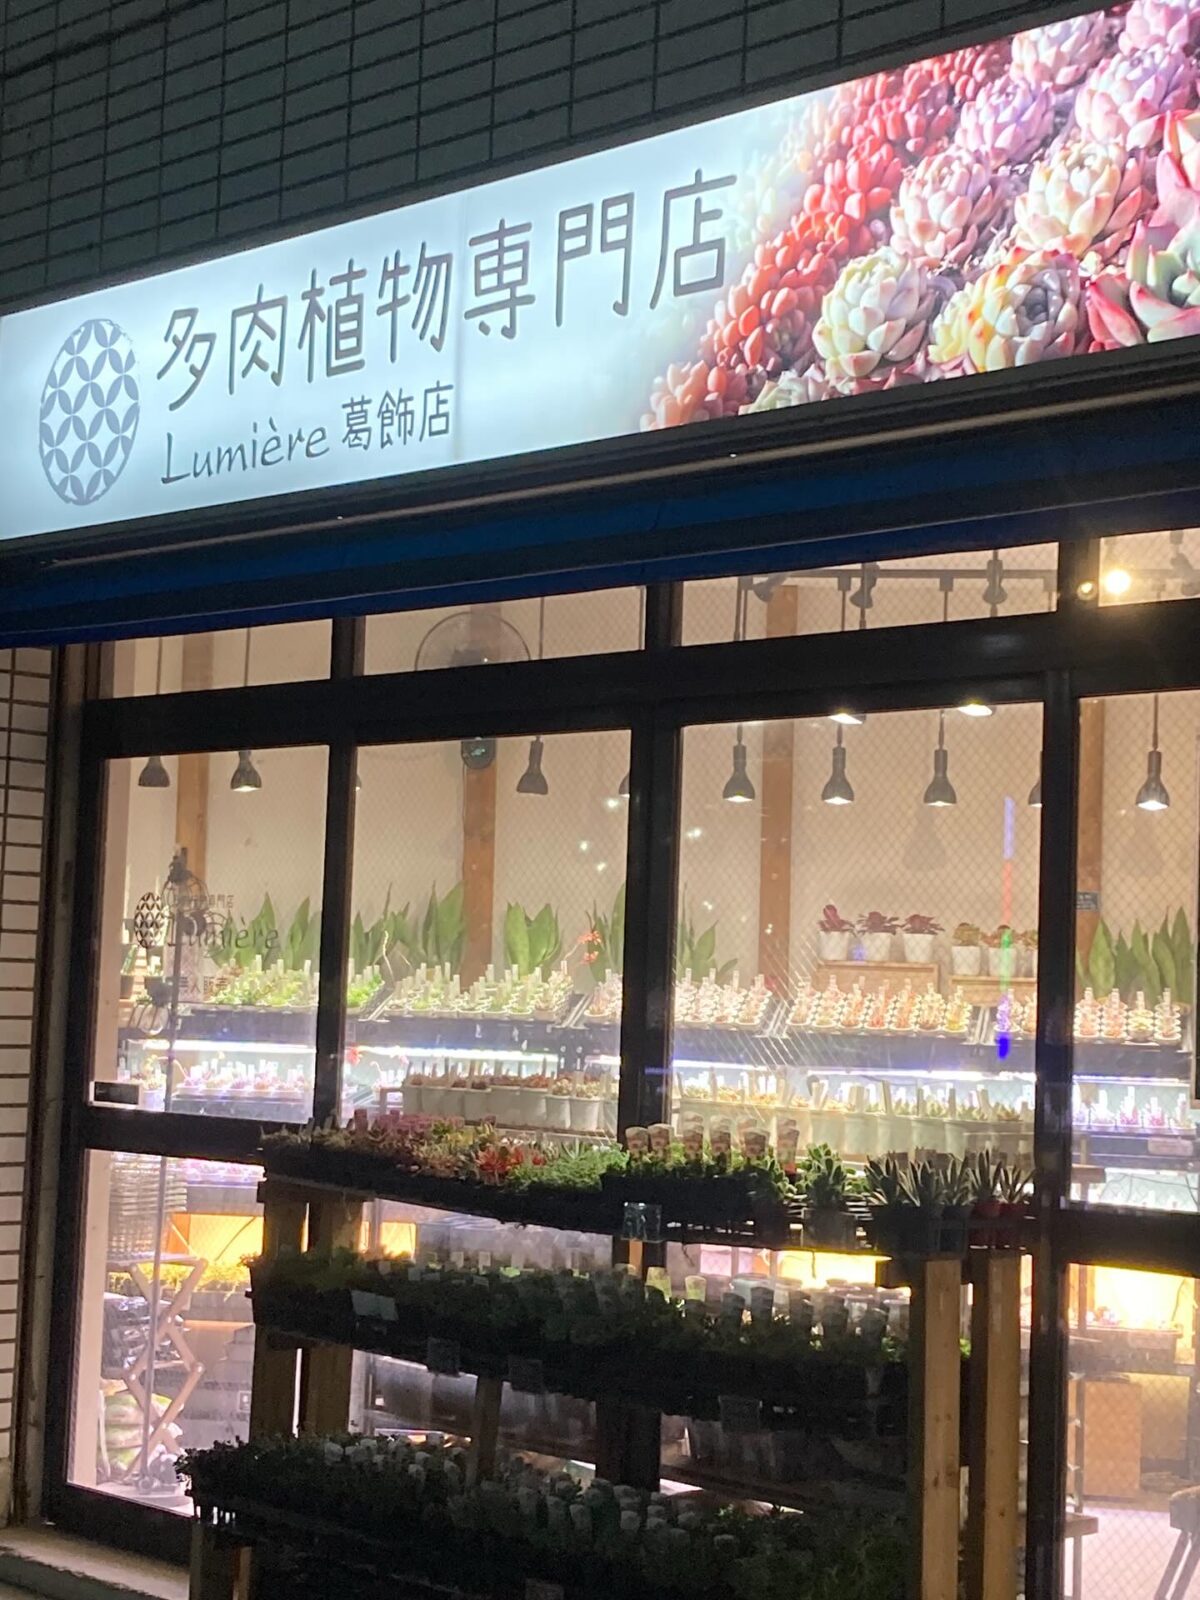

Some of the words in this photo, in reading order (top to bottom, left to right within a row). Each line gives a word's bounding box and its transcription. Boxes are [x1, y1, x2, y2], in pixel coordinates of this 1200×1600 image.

[155, 168, 738, 412] 多肉植物専門店
[161, 416, 330, 484] Lumière
[341, 380, 455, 451] 葛飾店
